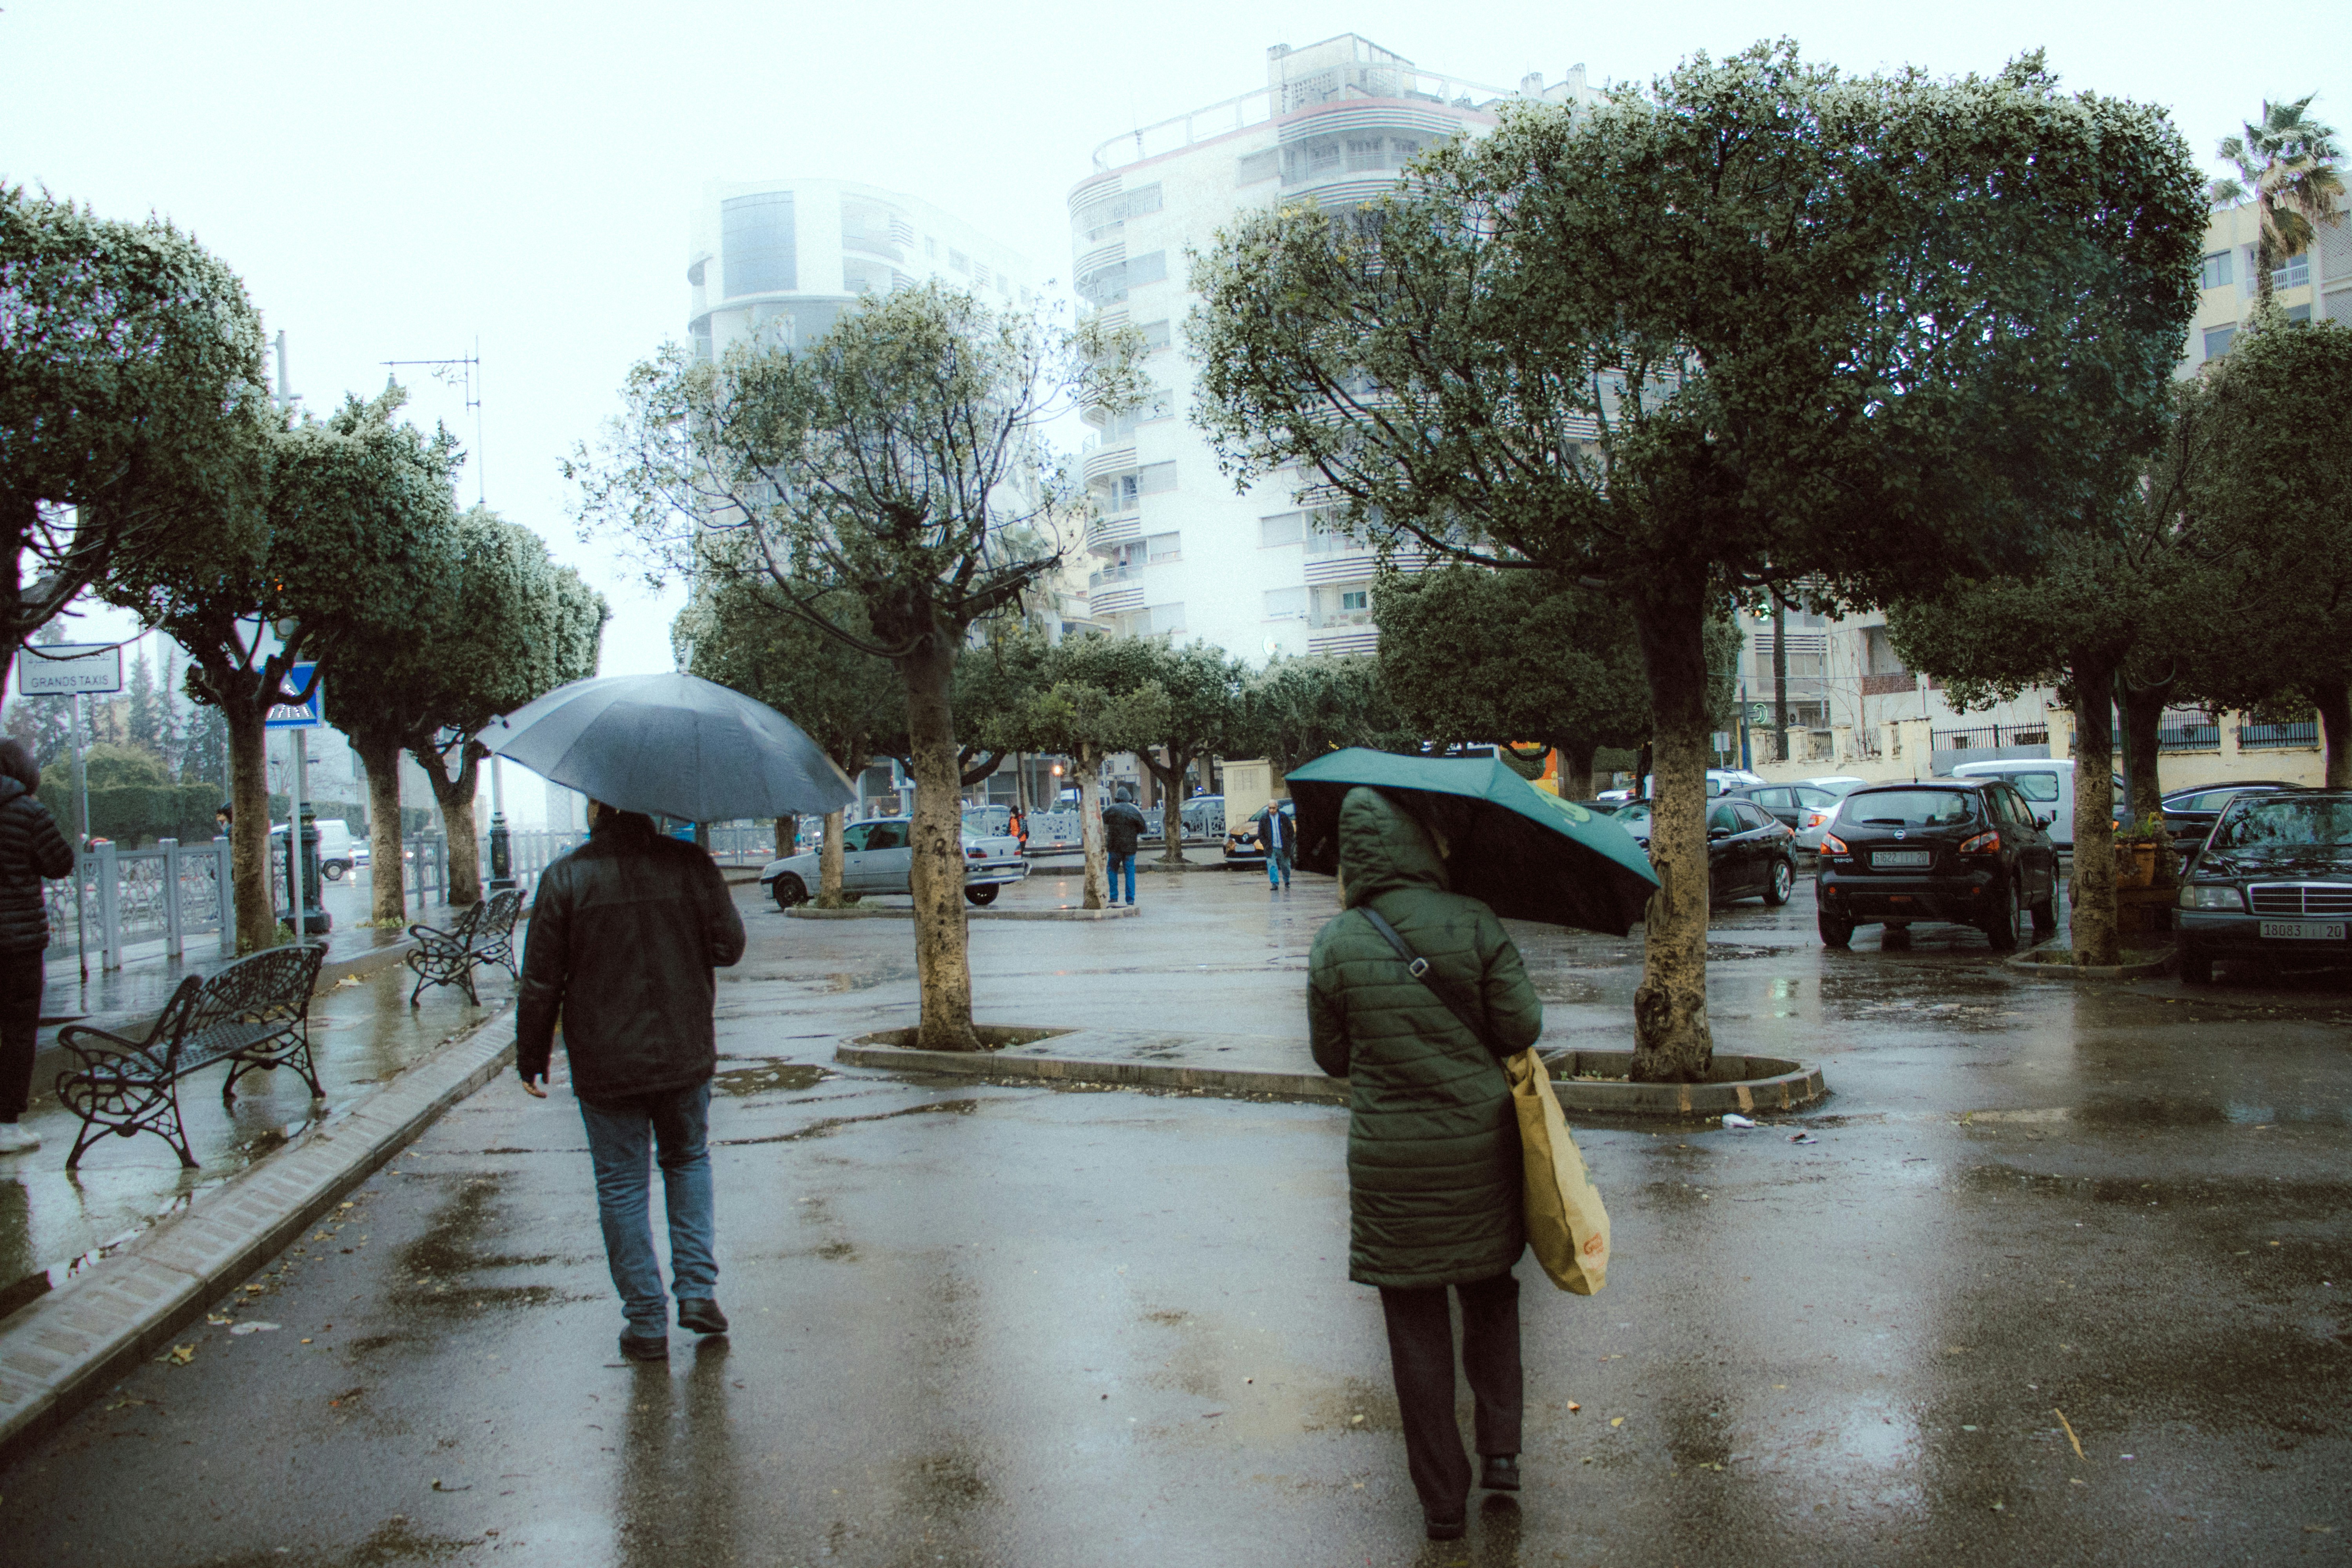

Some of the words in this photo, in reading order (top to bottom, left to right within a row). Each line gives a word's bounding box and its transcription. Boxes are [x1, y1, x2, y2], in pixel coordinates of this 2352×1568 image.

[31, 676, 76, 688] GRANDS
[79, 675, 109, 686] TAXIS
[1875, 853, 1896, 862] 61622
[1917, 852, 1927, 862] 20
[2264, 924, 2301, 936] 18083
[2327, 926, 2341, 937] 20
